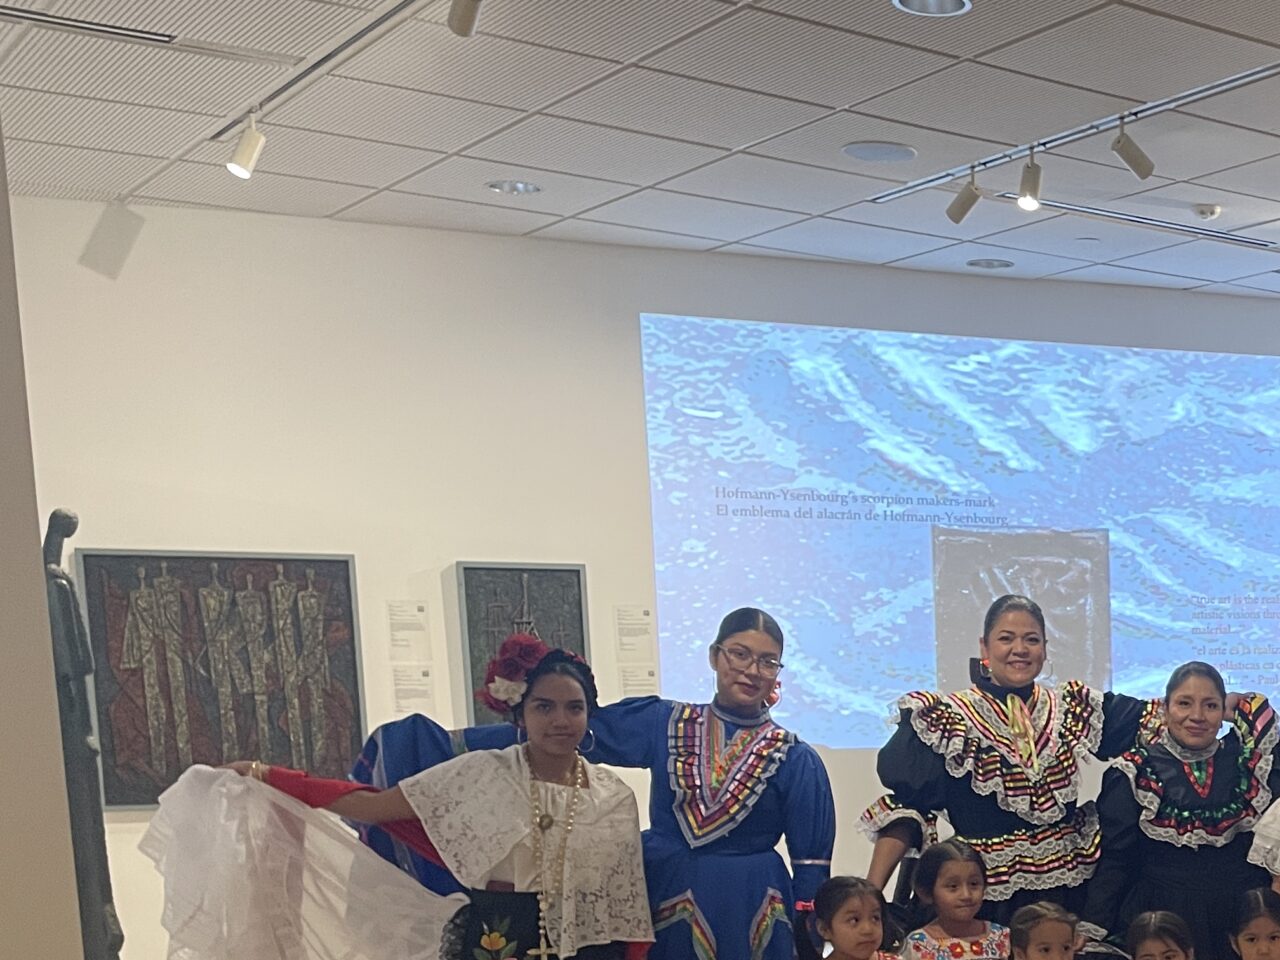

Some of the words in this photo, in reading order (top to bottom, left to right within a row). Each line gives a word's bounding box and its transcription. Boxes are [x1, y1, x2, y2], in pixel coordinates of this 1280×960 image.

[715, 486, 858, 506] Hofmann-Ysenbourg's
[861, 494, 914, 508] scorpion
[916, 494, 996, 509] makers-mark
[716, 504, 728, 516] El
[732, 505, 790, 518] emblema
[794, 506, 813, 519] del
[817, 508, 862, 520] alacrán
[865, 509, 880, 521] de
[883, 510, 1008, 527] Hofmann-Ysenbourg
[1218, 595, 1231, 604] art
[1233, 594, 1242, 604] is
[1244, 594, 1259, 604] the
[1227, 611, 1261, 619] visions
[1208, 645, 1227, 655] arte
[1263, 662, 1274, 670] en
[1258, 674, 1279, 685] Paul
